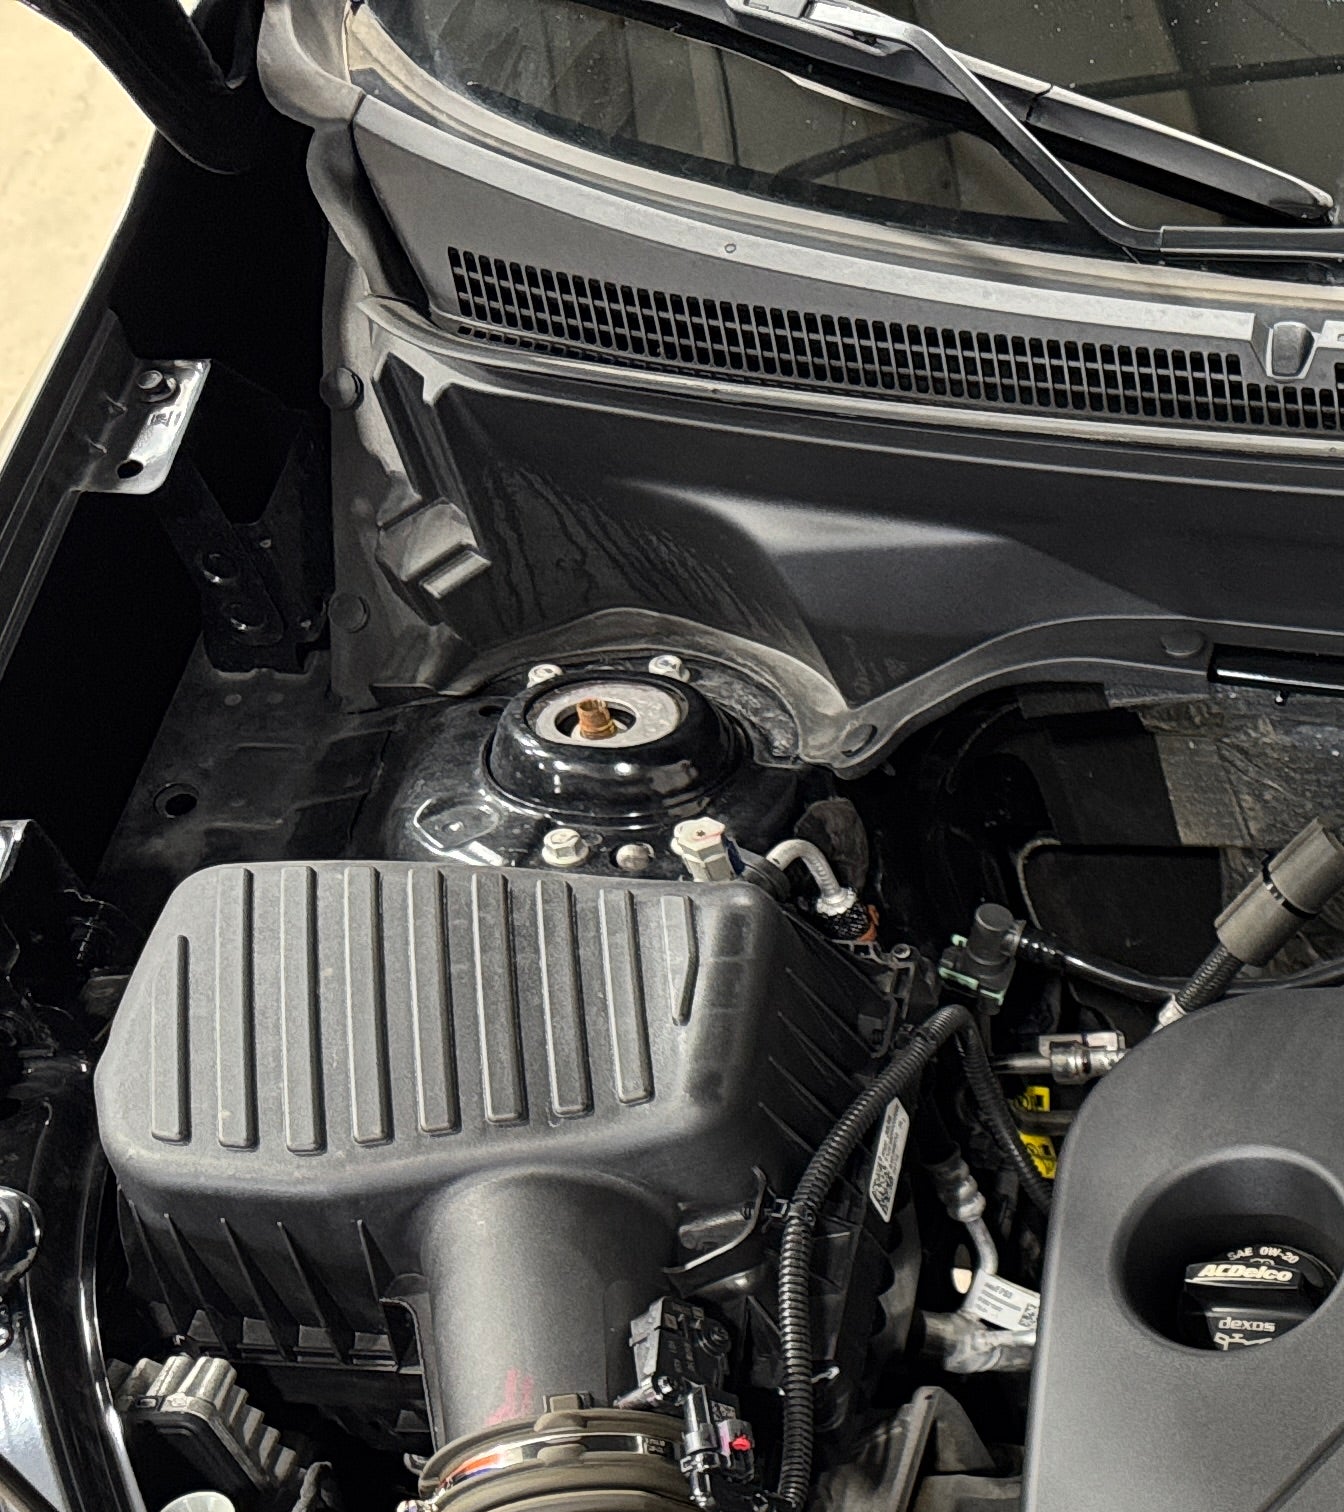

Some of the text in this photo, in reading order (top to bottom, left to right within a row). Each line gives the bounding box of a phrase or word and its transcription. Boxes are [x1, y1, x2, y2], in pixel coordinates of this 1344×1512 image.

[1227, 1247, 1253, 1260] SAE
[1198, 1264, 1293, 1281] ACDelco
[1219, 1317, 1275, 1332] dexos
